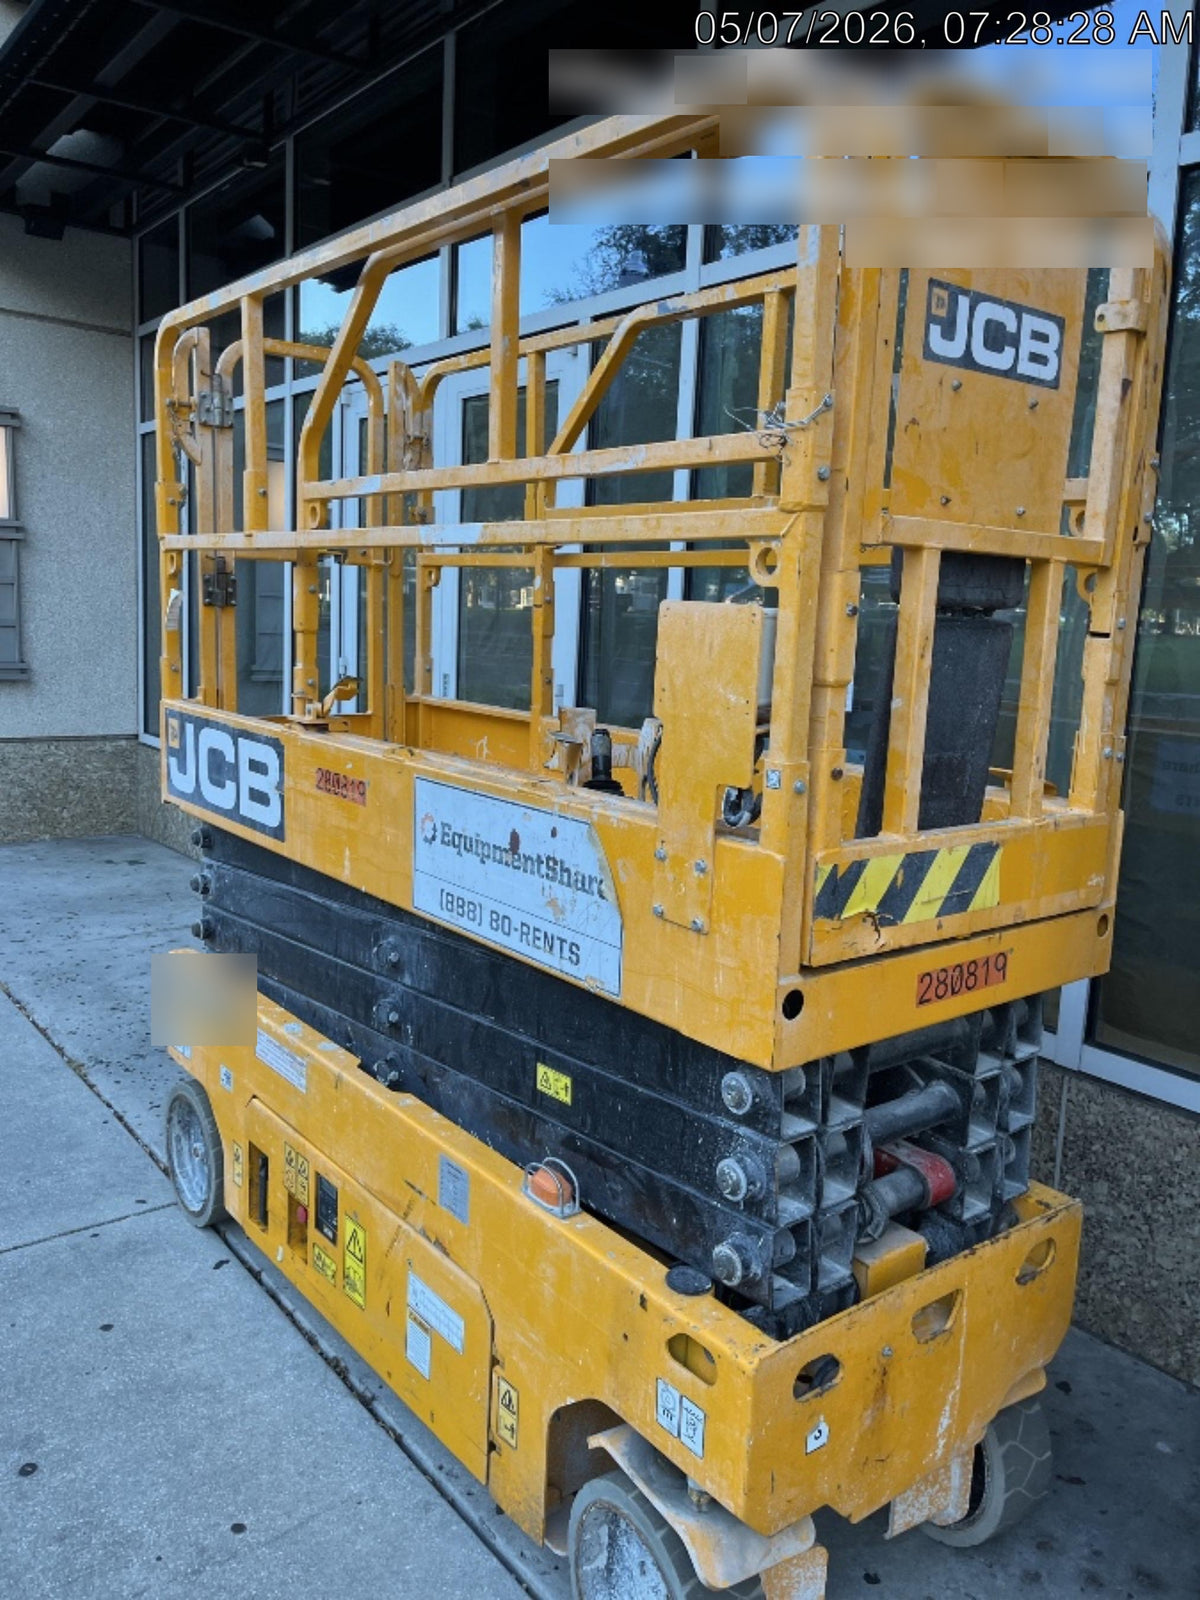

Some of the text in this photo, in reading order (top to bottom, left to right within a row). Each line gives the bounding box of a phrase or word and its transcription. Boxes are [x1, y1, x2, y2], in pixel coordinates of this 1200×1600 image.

[929, 294, 1060, 381] JCB
[168, 722, 281, 828] JCB
[440, 888, 581, 966] (888) 80-RENTS
[918, 952, 1008, 1005] 280819
